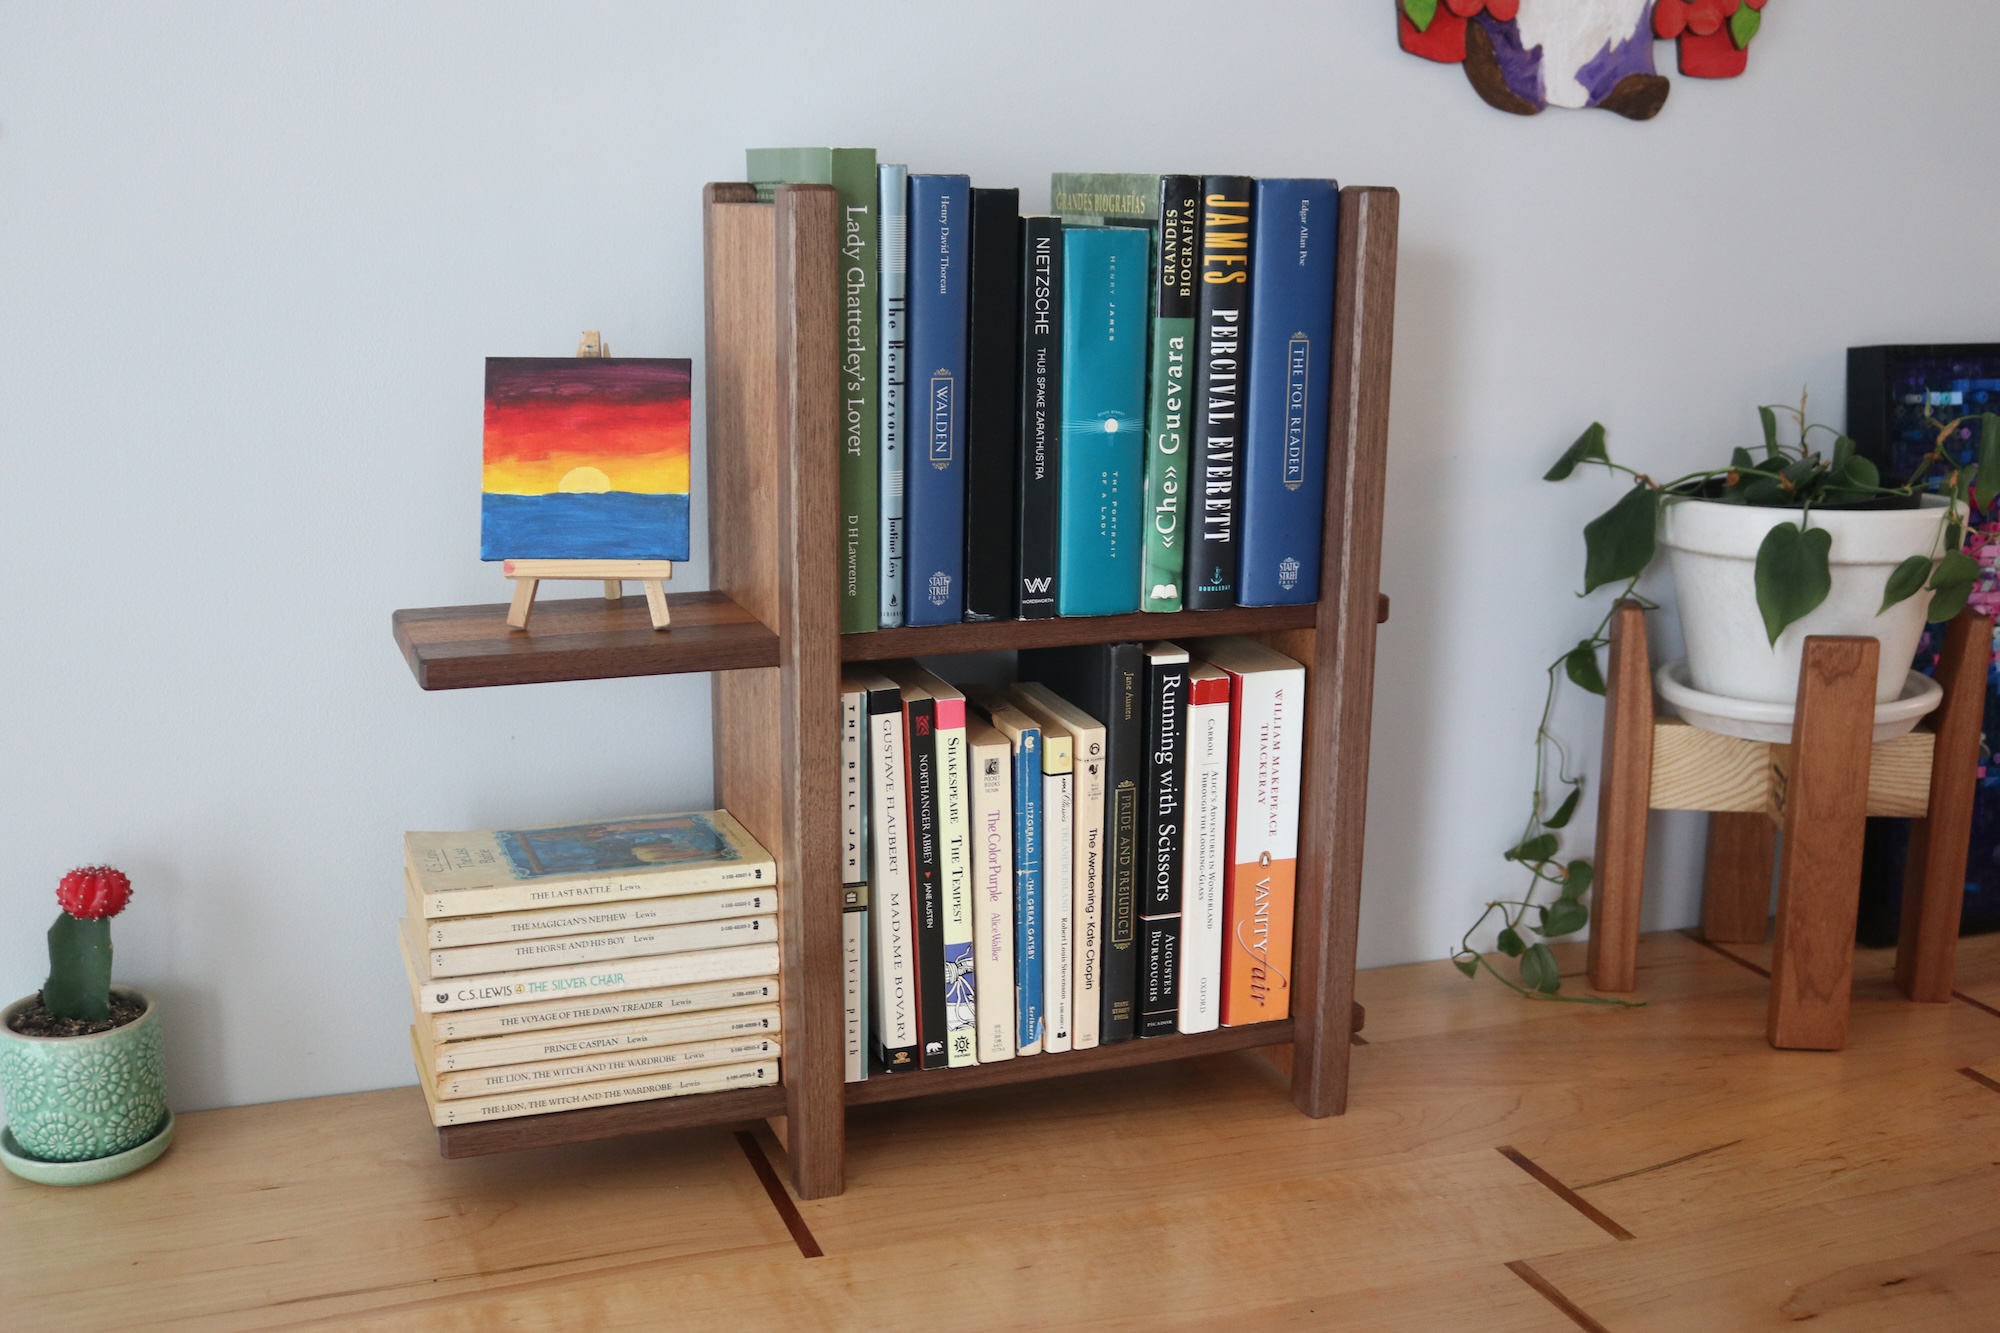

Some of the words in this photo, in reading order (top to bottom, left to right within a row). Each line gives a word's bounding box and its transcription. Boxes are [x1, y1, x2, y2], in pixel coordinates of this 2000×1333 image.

[939, 195, 950, 225] Henry
[1056, 192, 1093, 211] GRANDES
[1094, 190, 1146, 214] BIOGRAFÍAS
[1298, 199, 1310, 225] Edgar
[842, 205, 868, 261] Lady
[940, 227, 950, 254] David
[1163, 208, 1179, 286] GRANDES
[1180, 198, 1195, 297] BIOGRAFÍAS
[1203, 193, 1250, 285] JAMES
[1299, 226, 1309, 249] Allan
[940, 256, 950, 295] Thoreau
[1109, 255, 1117, 295] HENRY
[1298, 250, 1308, 267] Poe
[1034, 237, 1051, 335] NIETZSCHE
[842, 267, 866, 391] Chatterley's
[888, 298, 905, 329] The
[1036, 347, 1047, 375] THUS
[1208, 308, 1239, 425] PERCIVAL
[1292, 347, 1304, 376] THE
[887, 340, 905, 451] Rendezvous
[1036, 376, 1046, 409] SPAKE
[1158, 336, 1185, 455] Guevara
[1291, 383, 1303, 411] POE
[847, 397, 865, 456] Lover
[936, 385, 949, 453] WALDEN
[1035, 410, 1046, 481] ZARATHUSTRA
[1288, 417, 1302, 475] READER
[1101, 471, 1108, 485] OF
[1203, 436, 1235, 543] EVERETT
[848, 515, 859, 525] D
[1155, 466, 1178, 549] «Che»
[848, 528, 859, 538] H
[888, 517, 902, 553] Justine
[1110, 501, 1118, 558] PORTRAIT
[848, 541, 859, 597] Lawrence
[1198, 584, 1231, 592] DOUBLEDAY
[1123, 671, 1135, 690] Jane
[848, 705, 856, 743] THE
[1125, 692, 1134, 720] Austen
[1154, 674, 1181, 764] Running
[1272, 688, 1284, 751] WILLIAM
[883, 719, 895, 792] GUSTAVE
[1207, 718, 1216, 757] CARROLL
[947, 737, 960, 824] SHAKESPEARE
[1257, 722, 1269, 805] THACKERAY
[848, 761, 856, 811] BELL
[919, 754, 932, 831] NORTHANGER
[1160, 769, 1178, 816] with
[1200, 771, 1209, 812] THROUGH
[1268, 756, 1281, 837] MAKEPEACE
[987, 809, 1001, 832] The
[1025, 801, 1034, 853] FITZGERALD
[1121, 795, 1132, 831] PRIDE
[1209, 804, 1218, 858] ADVENTURES
[848, 828, 856, 867] JAR
[886, 796, 898, 875] FLAUBERT
[923, 833, 933, 865] ABBEY
[951, 835, 963, 863] THE
[987, 833, 1001, 865] Color
[1061, 827, 1070, 876] TREASURE
[1088, 828, 1098, 848] The
[1119, 837, 1131, 865] AND
[1085, 851, 1097, 913] Awakening
[1156, 823, 1177, 902] Scissors
[1198, 832, 1208, 901] LOOKING-GLASS
[530, 891, 550, 901] THE
[551, 888, 576, 899] LAST
[576, 885, 612, 896] BATTLE
[619, 882, 641, 891] Lewis
[923, 882, 933, 900] JANE
[952, 867, 964, 925] TEMPEST
[986, 865, 1002, 902] Purple
[1027, 880, 1035, 896] THE
[1061, 877, 1069, 913] ISLAND
[1118, 870, 1130, 935] PREJUDICE
[1207, 871, 1216, 930] WONDERLAND
[511, 922, 531, 932] THE
[532, 916, 588, 930] MAGICIAN'S
[588, 912, 628, 924] NEPHEW
[634, 910, 657, 919] Lewis
[891, 893, 902, 970] MADAME
[926, 900, 934, 929] AUSTEN
[990, 912, 1001, 932] Alice
[1027, 898, 1035, 926] GREAT
[1253, 876, 1270, 954] VANITY
[515, 946, 535, 956] THE
[536, 942, 567, 954] HORSE
[568, 940, 589, 950] AND
[590, 938, 606, 947] HIS
[607, 936, 625, 945] BOY
[633, 933, 655, 943] Lewis
[991, 932, 1002, 962] Walker
[1027, 928, 1035, 960] GATSBY
[1086, 922, 1096, 947] Kate
[845, 938, 858, 994] sylvia
[1084, 949, 1095, 990] Chopin
[1149, 931, 1162, 1002] BURROUGHS
[1163, 934, 1176, 995] AUGUSTEN
[1237, 919, 1288, 1007] fair
[527, 981, 549, 994] THE
[551, 976, 587, 992] SILVER
[590, 972, 626, 987] CHAIR
[1199, 977, 1208, 1014] OXFORD
[500, 1016, 519, 1026] THE
[521, 1012, 558, 1024] VOYAGE
[559, 1011, 571, 1020] OF
[572, 1009, 591, 1018] THE
[592, 1005, 620, 1016] DAWN
[621, 1000, 663, 1012] TREADER
[671, 998, 692, 1007] Lewis
[895, 976, 906, 1041] BOVARY
[1028, 1006, 1036, 1040] Scribners
[544, 1042, 578, 1054] PRINCE
[578, 1038, 619, 1050] CASPIAN
[627, 1034, 648, 1044] Lewis
[846, 1008, 859, 1056] plath
[485, 1076, 505, 1086] THE
[506, 1073, 531, 1083] LION,
[533, 1070, 552, 1080] THE
[553, 1066, 585, 1077] WITCH
[586, 1063, 607, 1073] AND
[608, 1060, 626, 1070] THE
[627, 1054, 677, 1068] WARDROBE
[684, 1051, 705, 1061] Lewis
[481, 1106, 501, 1116] THE
[501, 1103, 527, 1113] LION,
[528, 1099, 548, 1110] THE
[548, 1095, 580, 1106] WITCH
[582, 1092, 602, 1103] AND
[603, 1090, 621, 1099] THE
[622, 1083, 673, 1096] WARDROBE
[680, 1079, 701, 1089] Lewis
